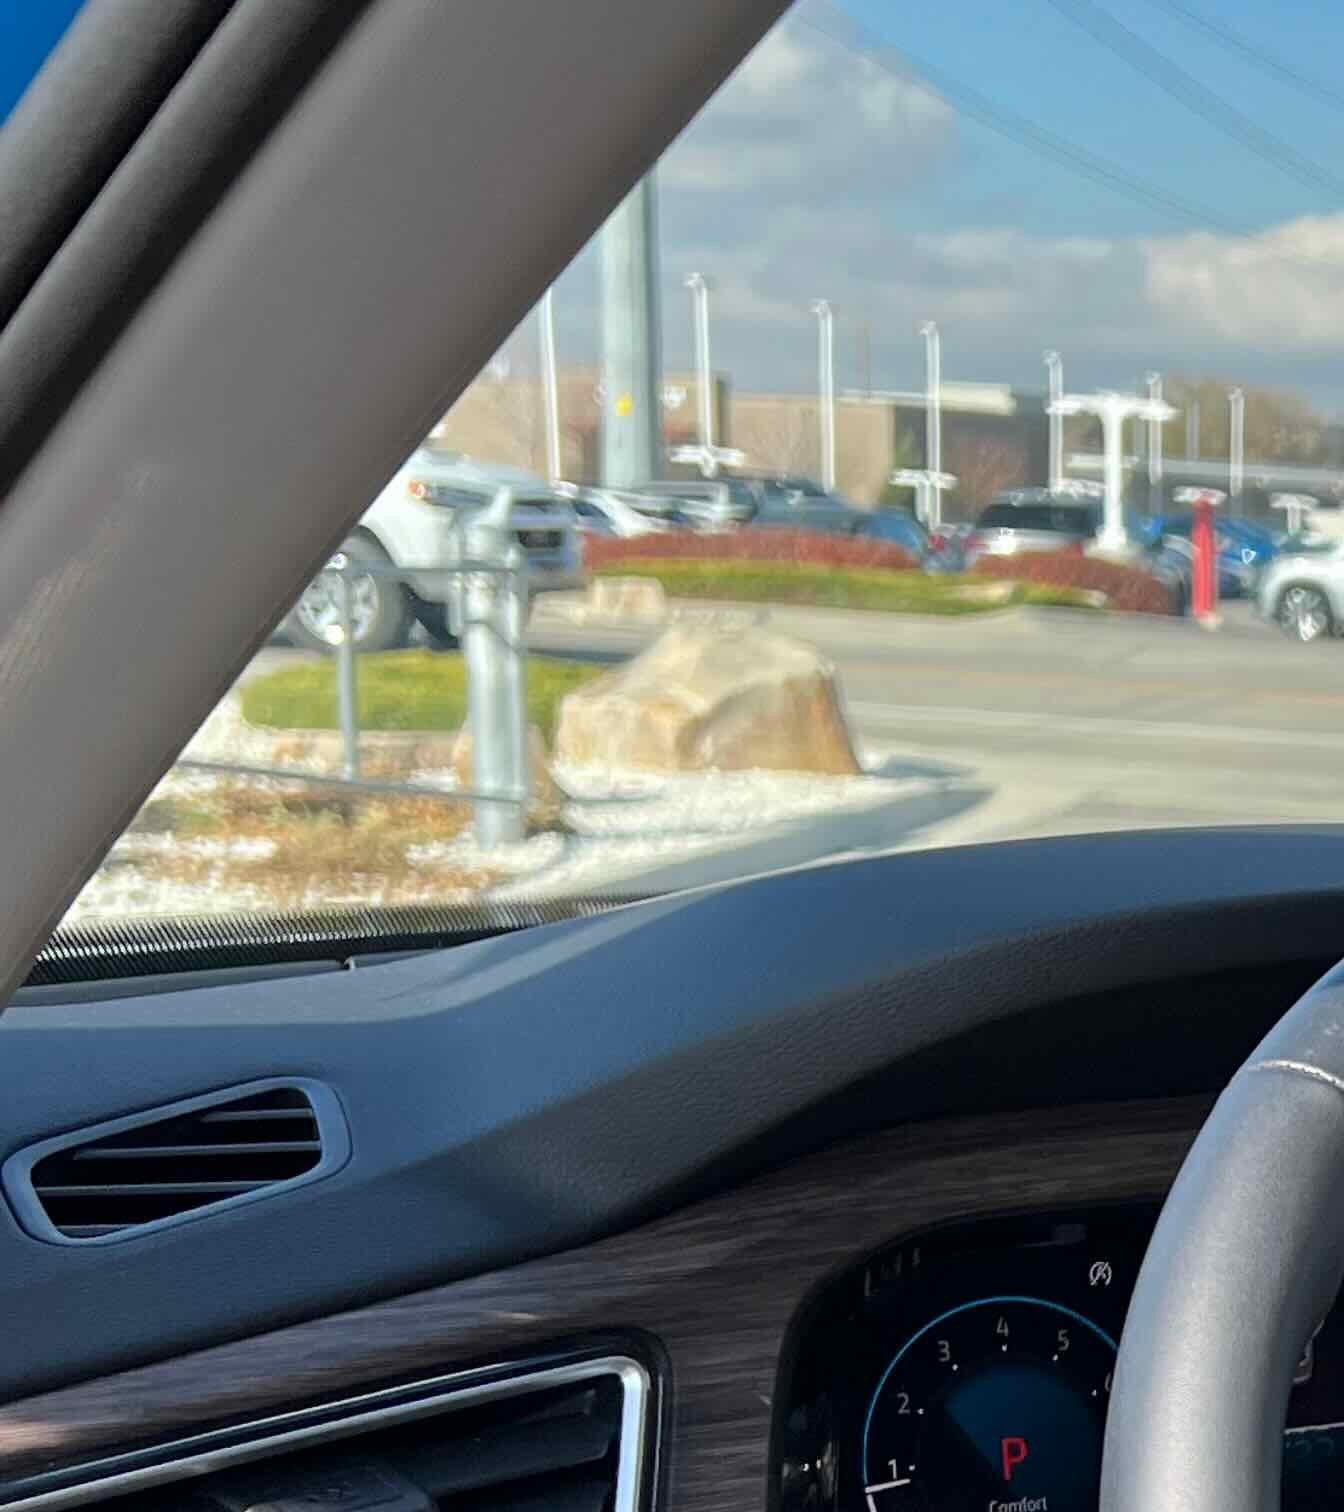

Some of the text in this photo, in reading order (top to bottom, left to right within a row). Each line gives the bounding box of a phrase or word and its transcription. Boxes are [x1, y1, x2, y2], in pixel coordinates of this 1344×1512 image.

[996, 1317, 1009, 1336] 4
[1057, 1331, 1070, 1350] 5
[937, 1341, 951, 1361] 3
[897, 1394, 910, 1413] 2
[1001, 1437, 1028, 1480] P
[887, 1459, 899, 1478] 1
